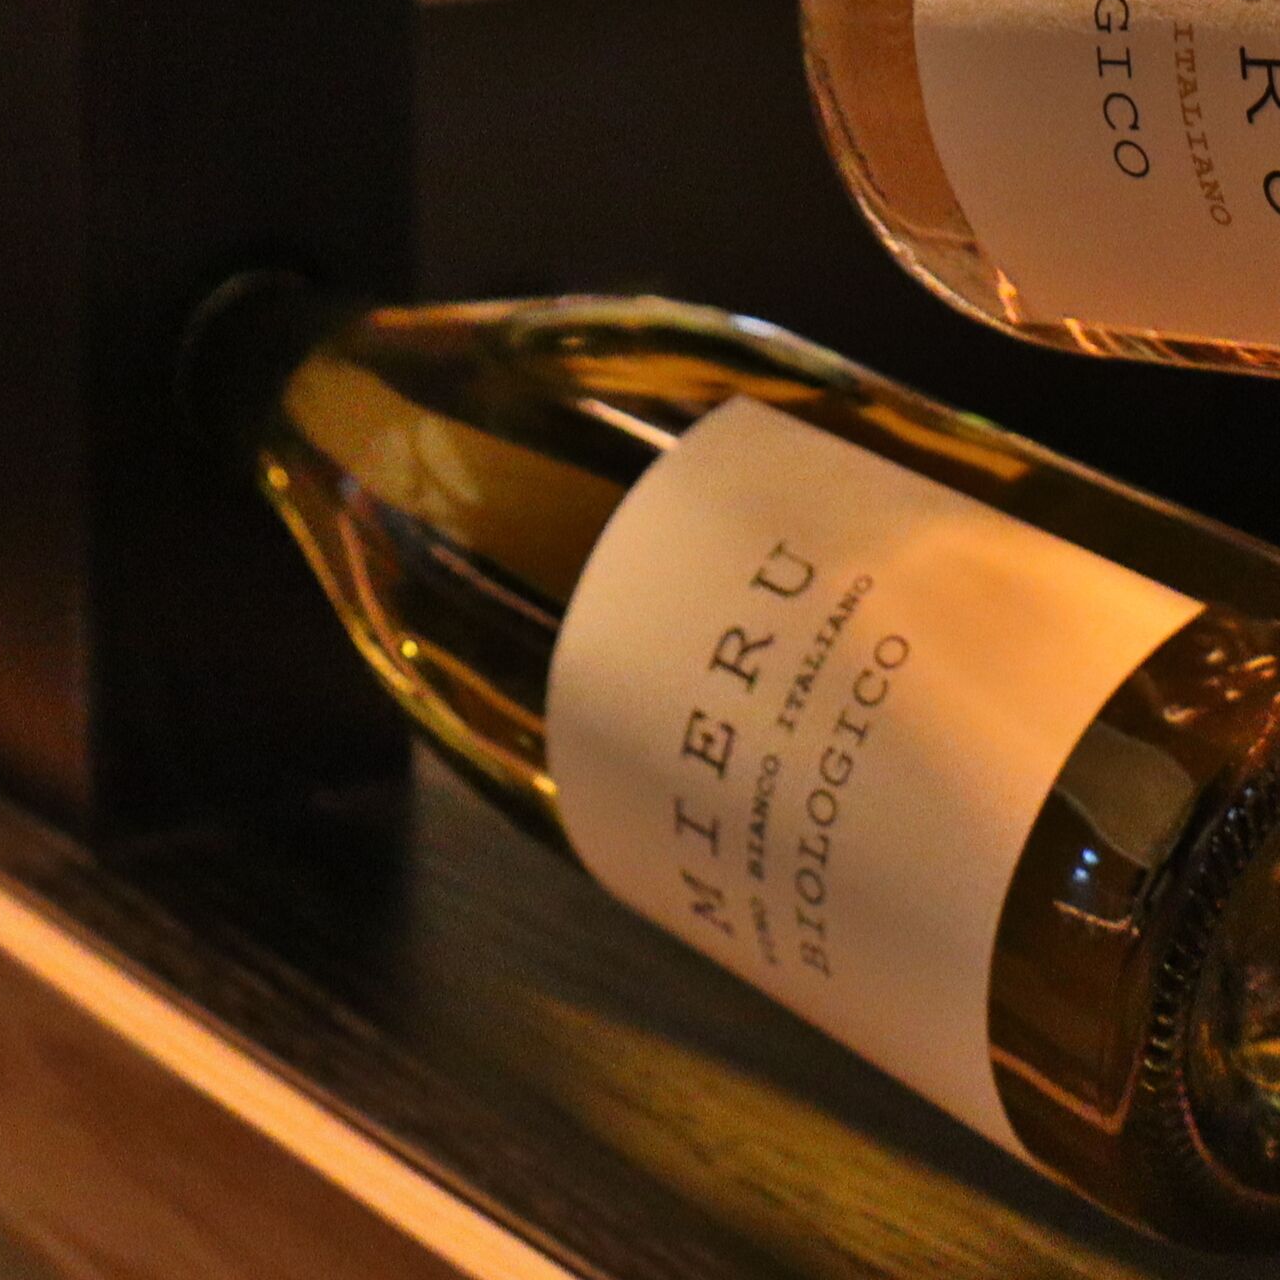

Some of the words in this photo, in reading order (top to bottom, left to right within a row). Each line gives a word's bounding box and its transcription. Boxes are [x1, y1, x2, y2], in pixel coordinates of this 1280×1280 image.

[1173, 21, 1233, 228] ITALIANO
[673, 541, 816, 936] MIERU
[746, 753, 782, 882] BIANCO
[777, 573, 875, 734] ITALIANO
[795, 633, 911, 978] BIOLOGICO
